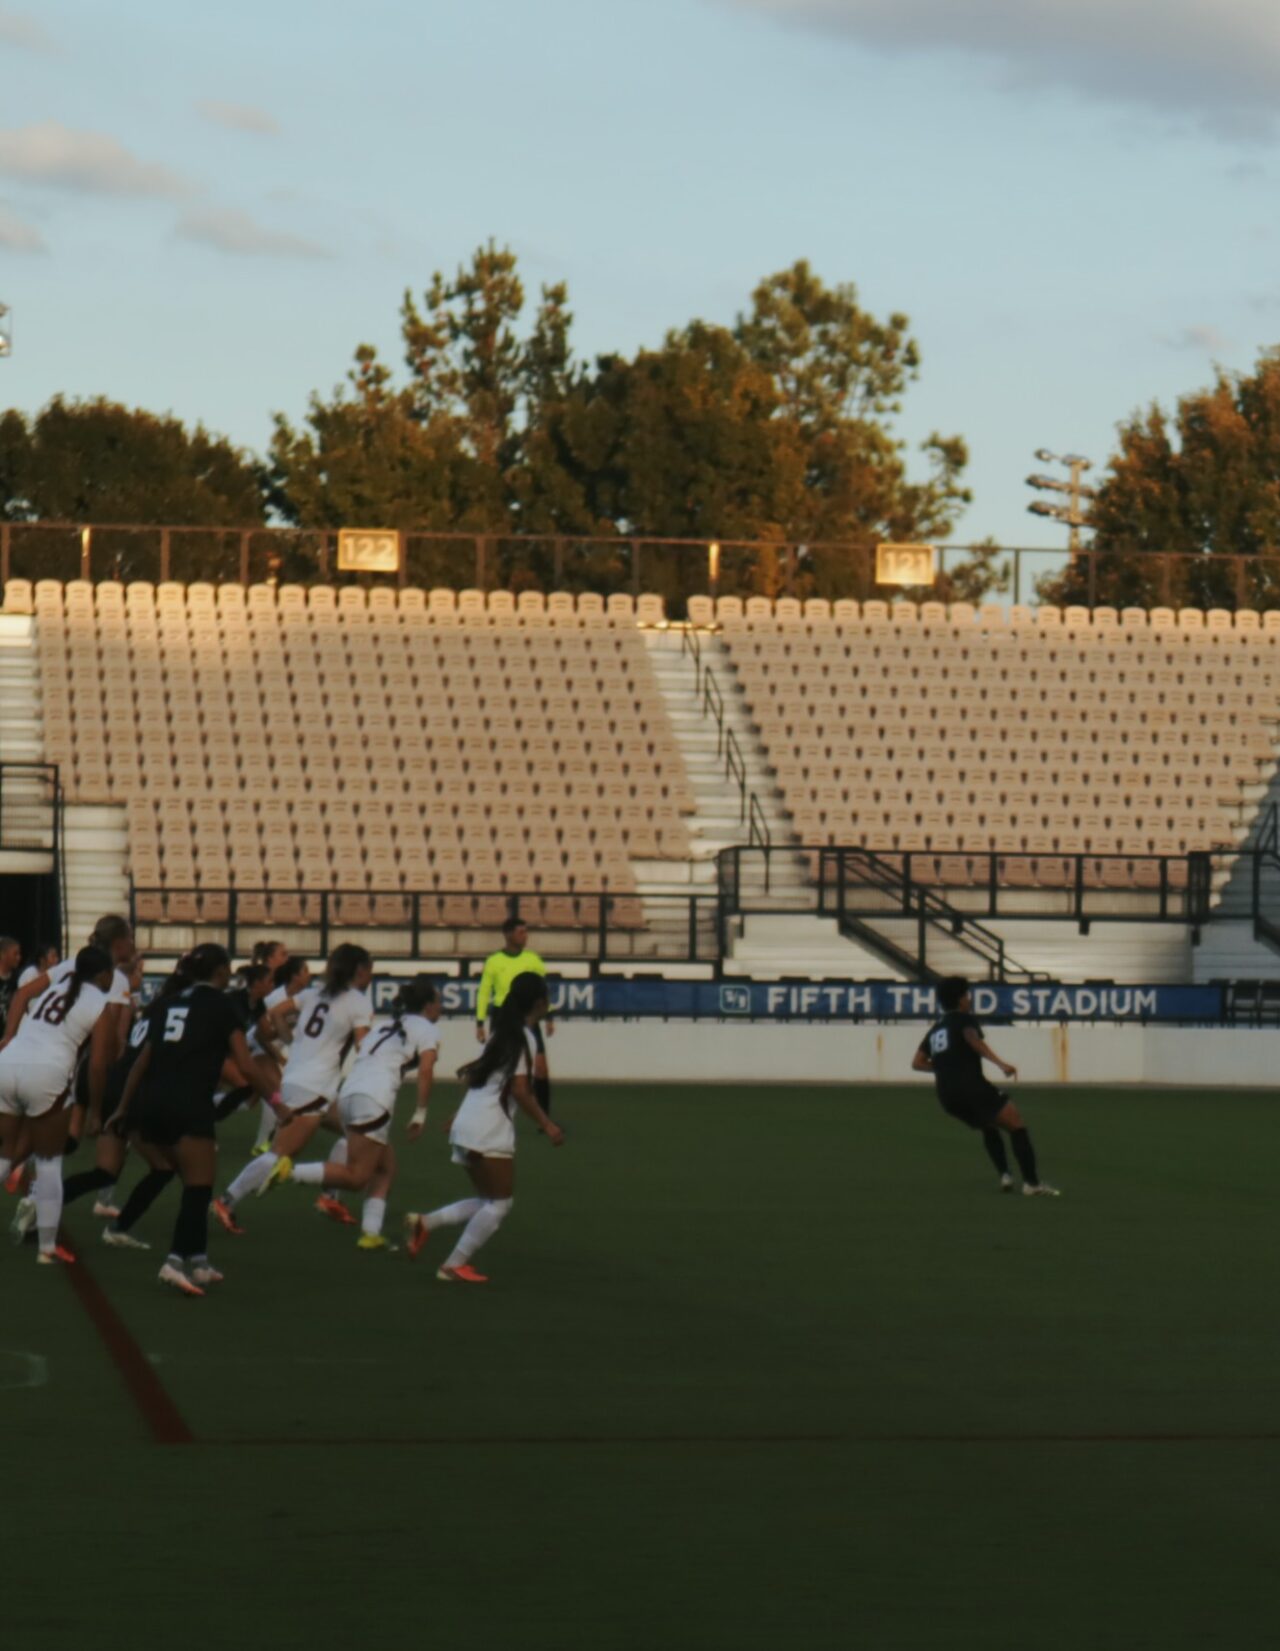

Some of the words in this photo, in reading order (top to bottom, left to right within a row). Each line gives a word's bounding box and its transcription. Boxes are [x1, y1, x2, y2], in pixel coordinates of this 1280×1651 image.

[343, 535, 393, 561] 122
[885, 552, 928, 577] 121
[32, 991, 67, 1026] 18
[768, 987, 871, 1014] FIFTH
[887, 987, 998, 1014] THD
[1013, 989, 1157, 1015] STADIUM
[164, 1007, 189, 1042] 5
[304, 1003, 330, 1038] 6
